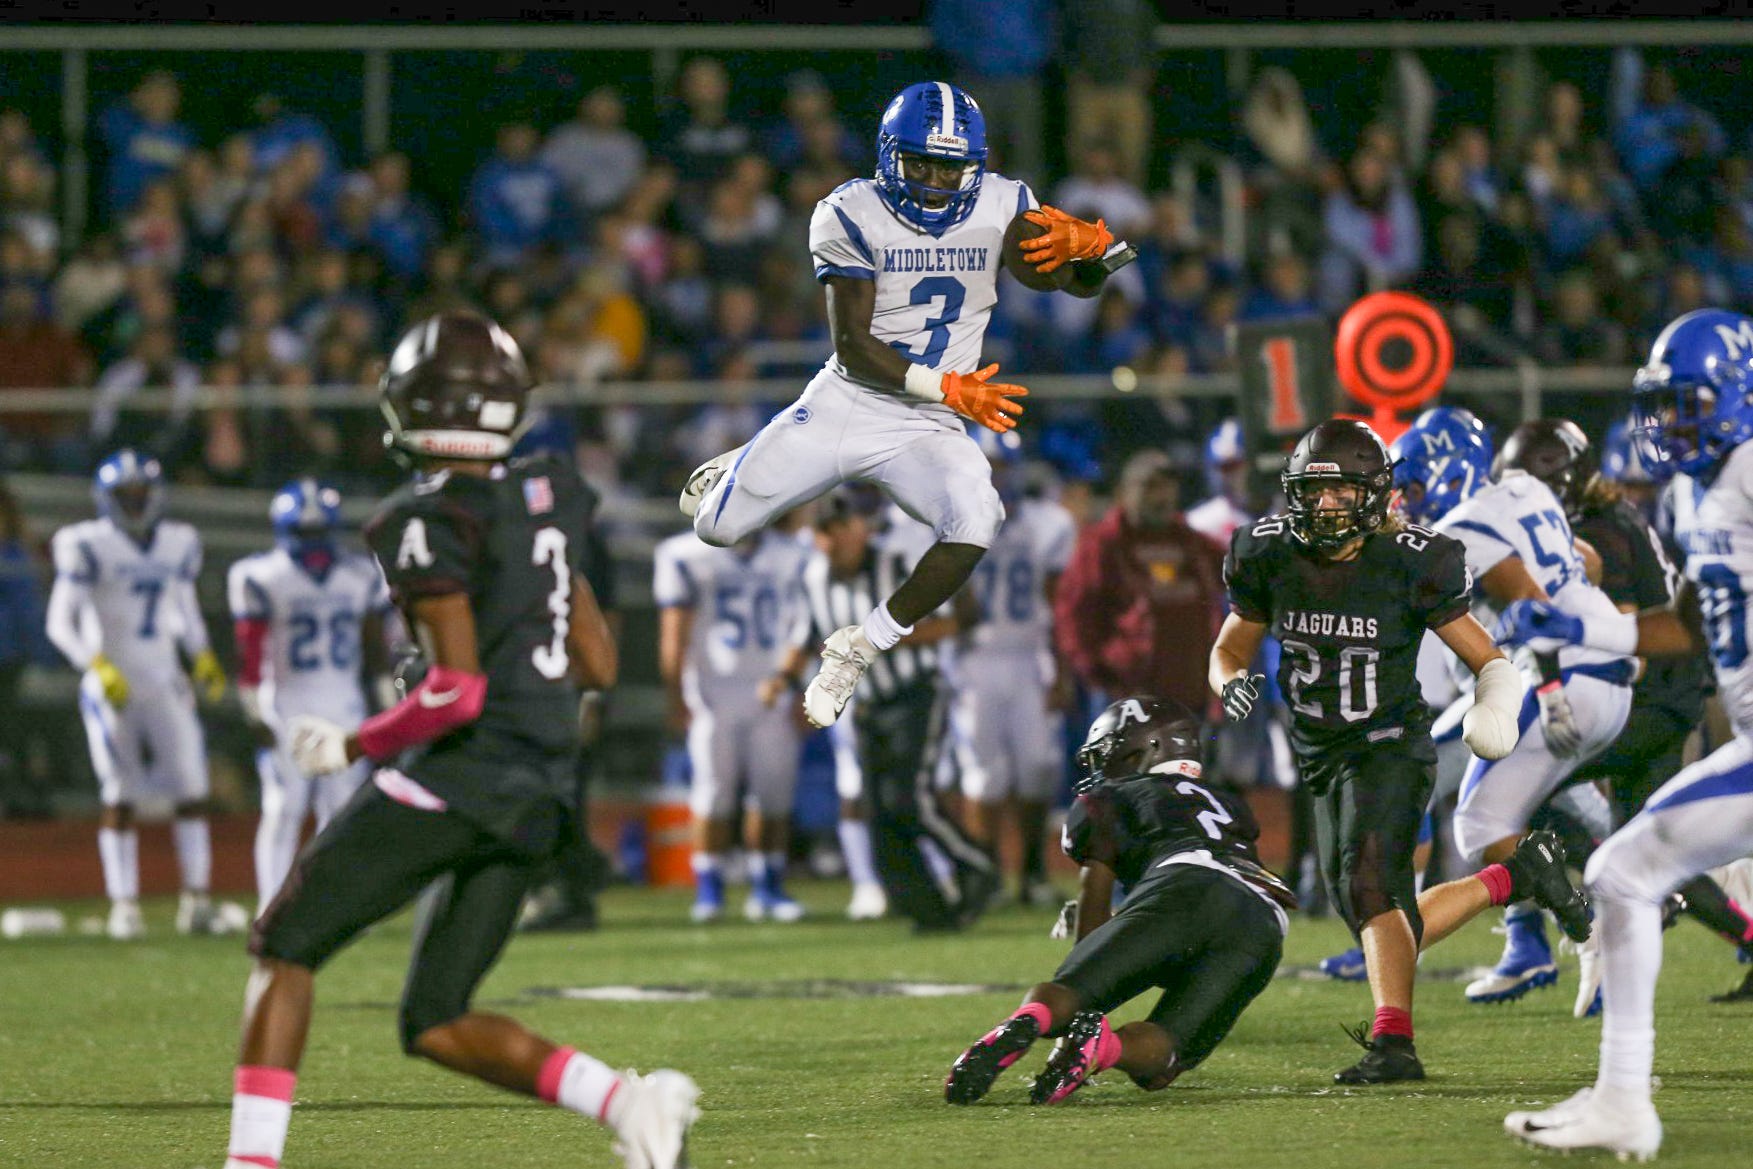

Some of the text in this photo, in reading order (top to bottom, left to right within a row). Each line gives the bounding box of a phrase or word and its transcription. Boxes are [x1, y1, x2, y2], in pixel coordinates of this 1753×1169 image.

[883, 247, 988, 273] MIDDLETOWN
[889, 276, 967, 370] 3
[1263, 337, 1306, 432] 1
[1420, 429, 1456, 456] M
[396, 516, 435, 569] A
[1396, 524, 1438, 552] 20
[129, 579, 165, 639] 7
[531, 526, 571, 680] 3
[714, 585, 778, 650] 50
[1283, 612, 1378, 639] JAGUARS
[1281, 639, 1380, 722] 20
[1115, 699, 1151, 731] A
[1175, 781, 1234, 841] 2
